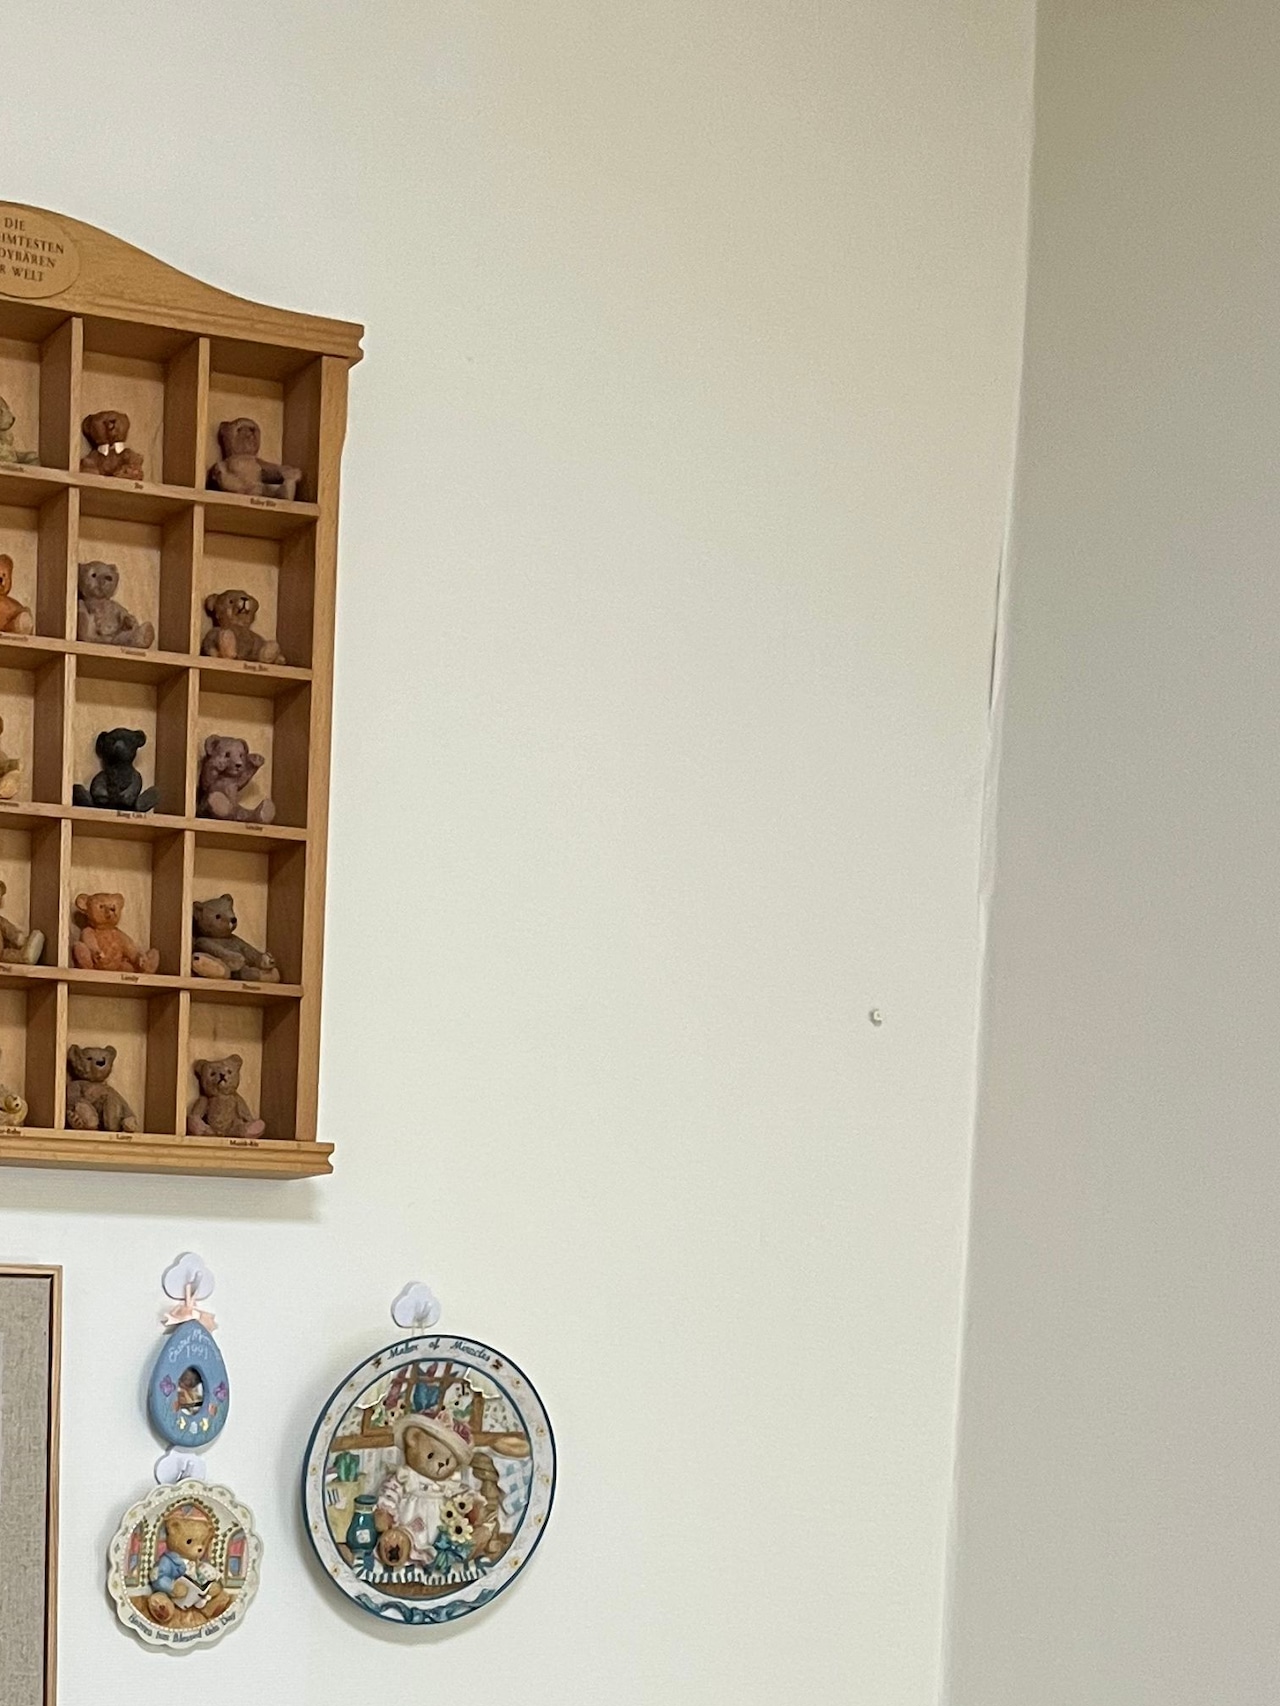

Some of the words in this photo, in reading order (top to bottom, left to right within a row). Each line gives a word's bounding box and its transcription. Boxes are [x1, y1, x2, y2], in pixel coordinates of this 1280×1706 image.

[4, 217, 26, 232] DIE
[11, 266, 44, 282] WELT
[429, 1337, 440, 1351] of
